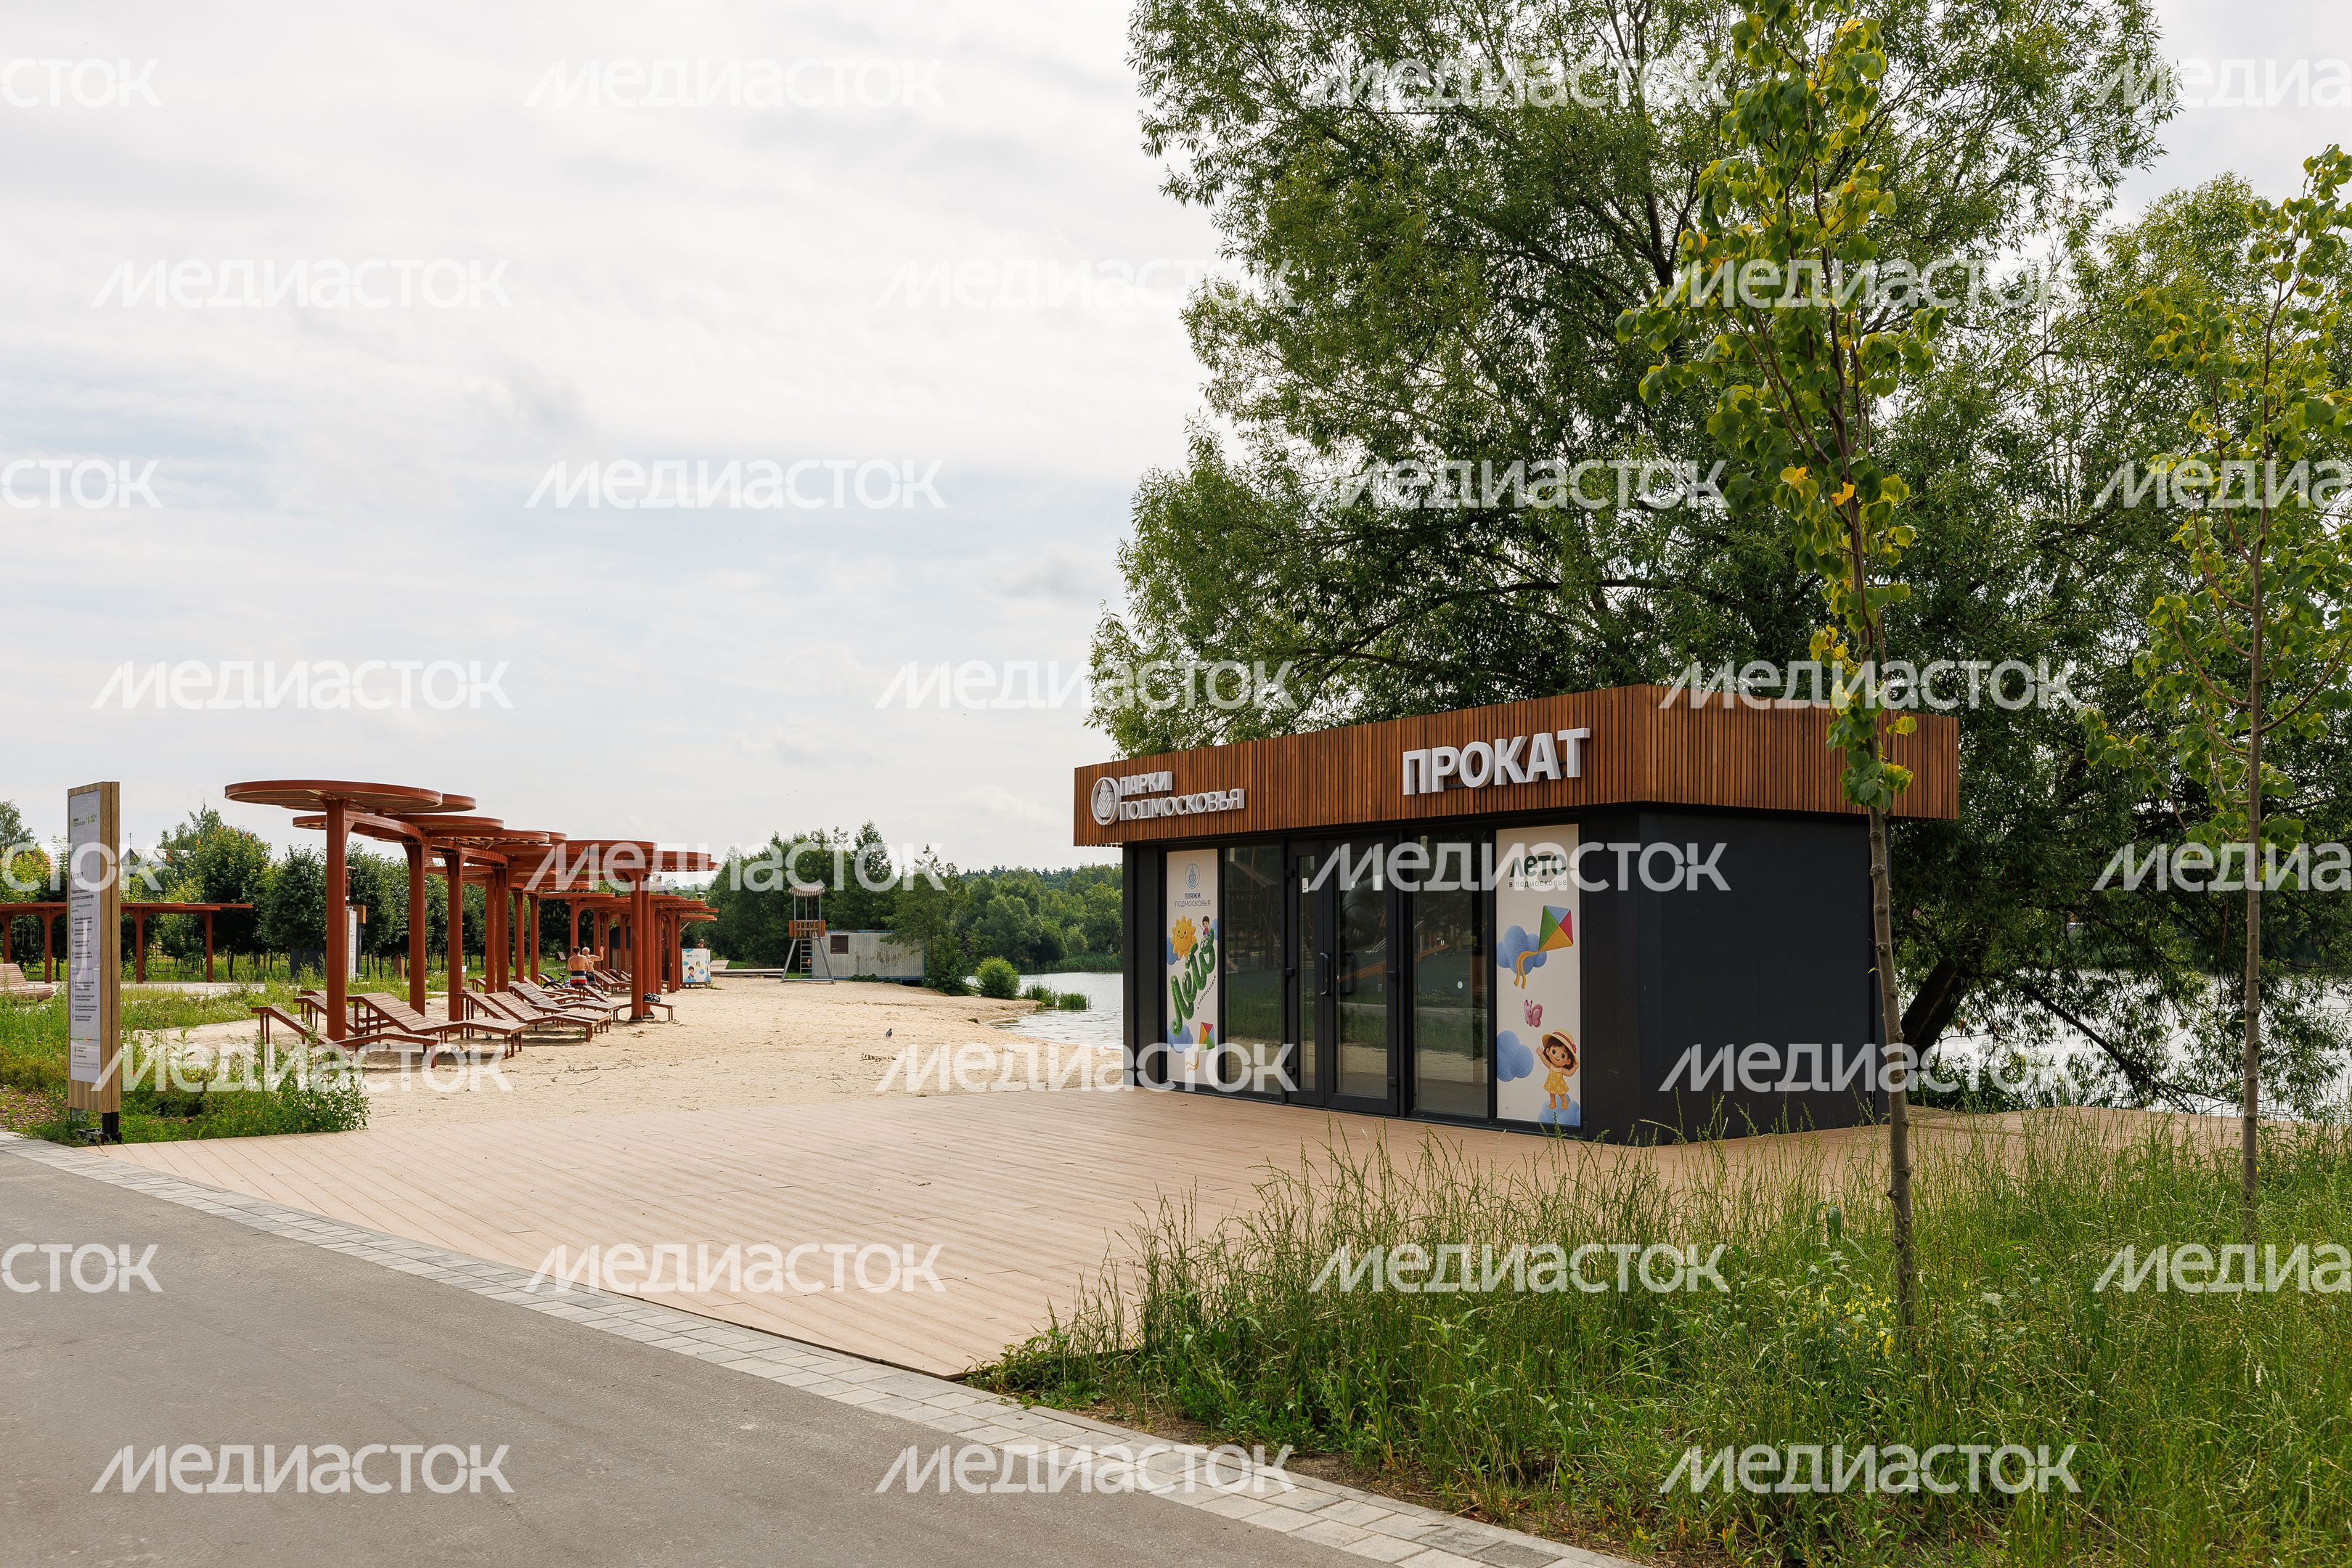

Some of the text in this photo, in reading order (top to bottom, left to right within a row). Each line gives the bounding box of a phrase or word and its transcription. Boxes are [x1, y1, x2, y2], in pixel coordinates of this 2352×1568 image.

[1403, 727, 1590, 796] ПРОКАТ
[1119, 771, 1172, 796] ПАРКИ
[1119, 788, 1244, 821] ПОДМОСКОВЬЯ
